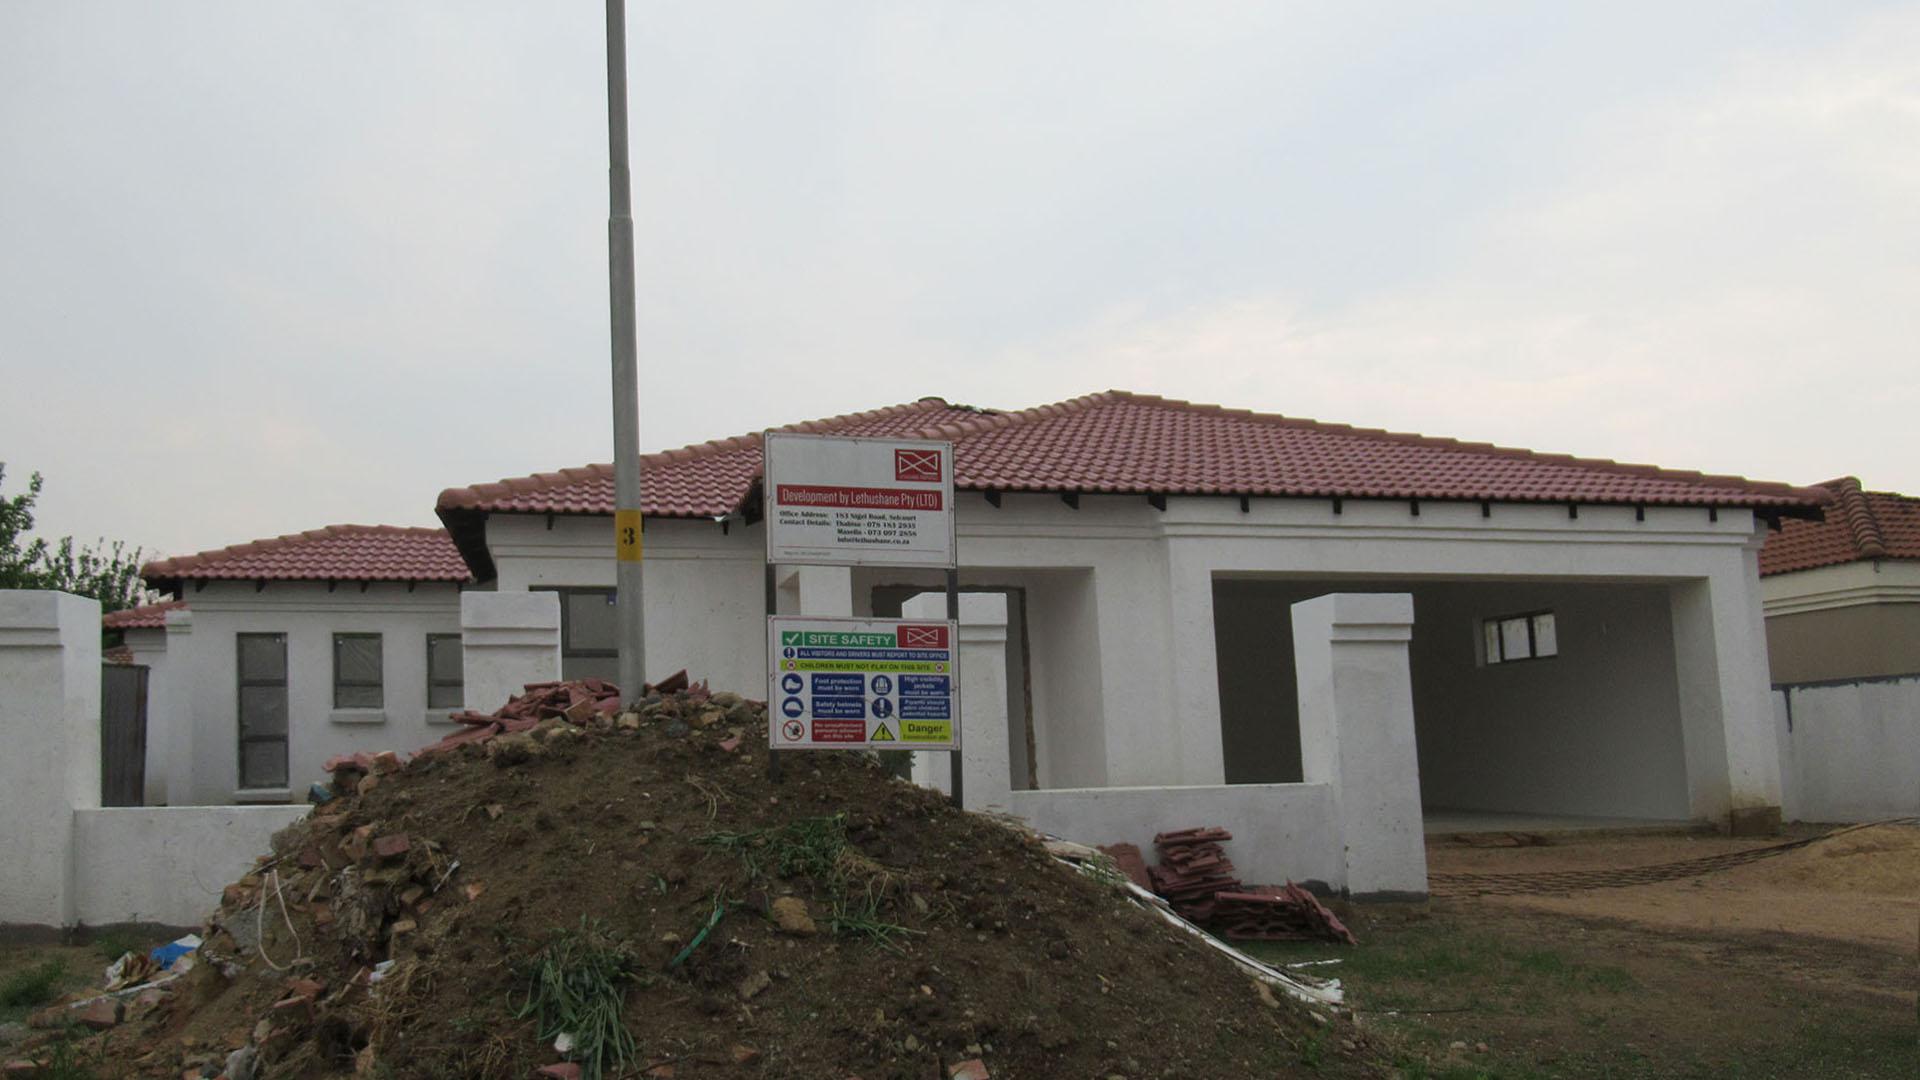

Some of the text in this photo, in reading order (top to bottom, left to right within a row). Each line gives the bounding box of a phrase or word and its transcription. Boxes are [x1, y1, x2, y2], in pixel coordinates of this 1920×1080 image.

[783, 488, 938, 508] Development by Lethushane Pty (LTD)
[779, 510, 799, 518] Office
[623, 527, 635, 545] 3
[809, 634, 891, 646] SITE SAFETY
[836, 650, 847, 658] AND
[908, 723, 943, 734] Danger
